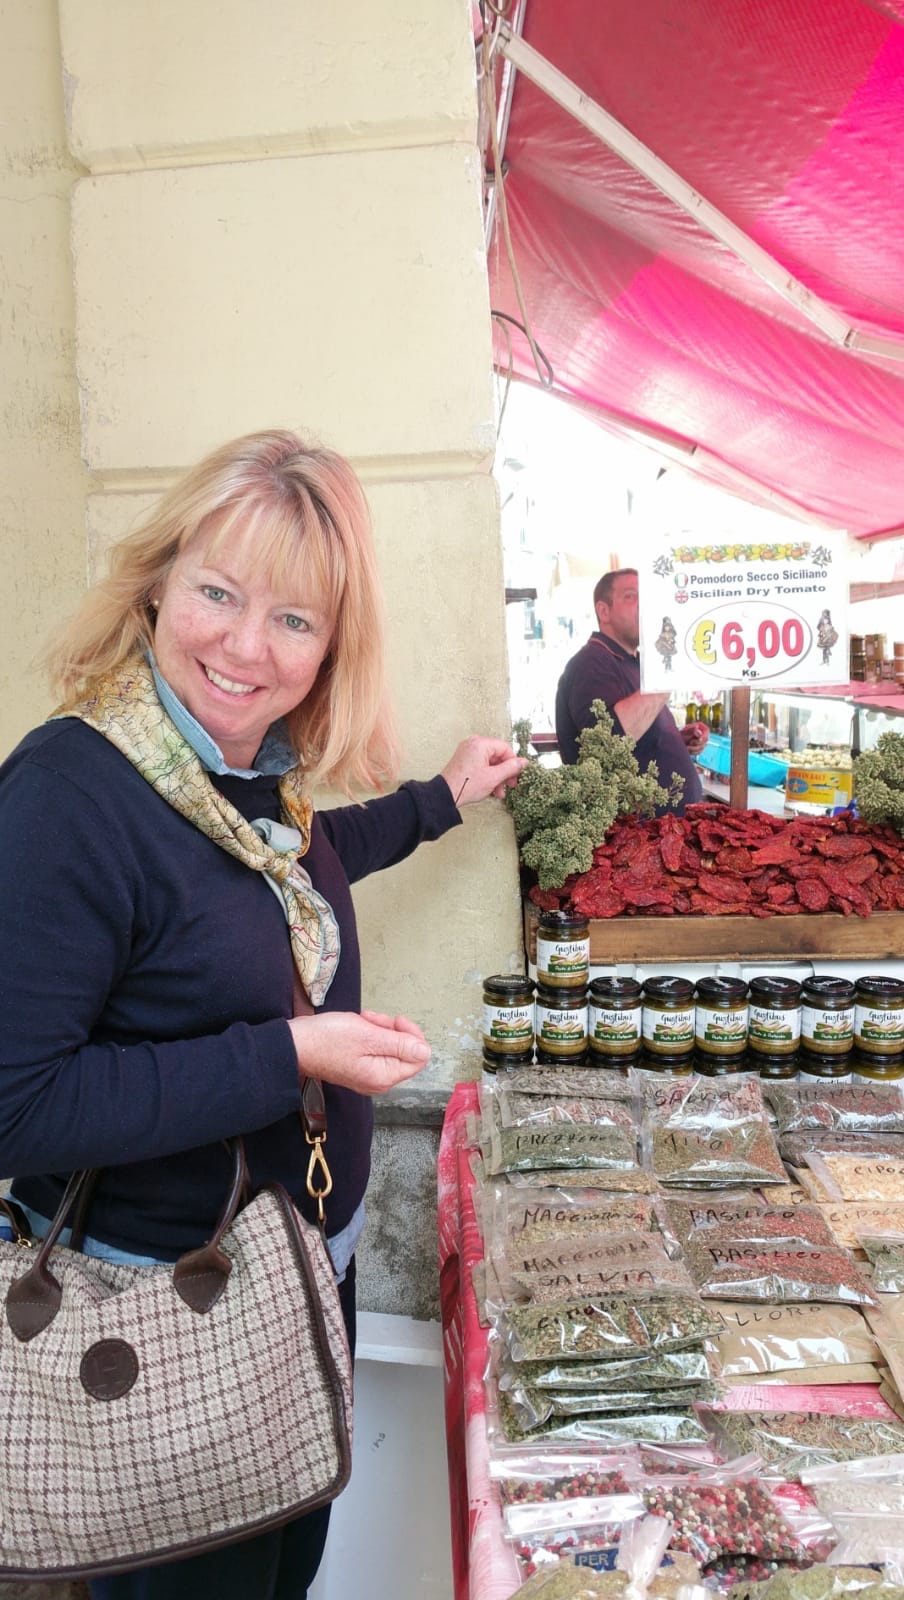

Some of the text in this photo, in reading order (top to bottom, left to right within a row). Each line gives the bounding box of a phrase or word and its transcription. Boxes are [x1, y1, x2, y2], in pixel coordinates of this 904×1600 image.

[690, 569, 827, 585] Pomodoro Secco Siciliano
[690, 584, 826, 599] Sicilian Dry Tomato
[721, 618, 804, 669] 6,00
[742, 669, 760, 678] Kg.
[709, 1246, 822, 1263] BASILICO
